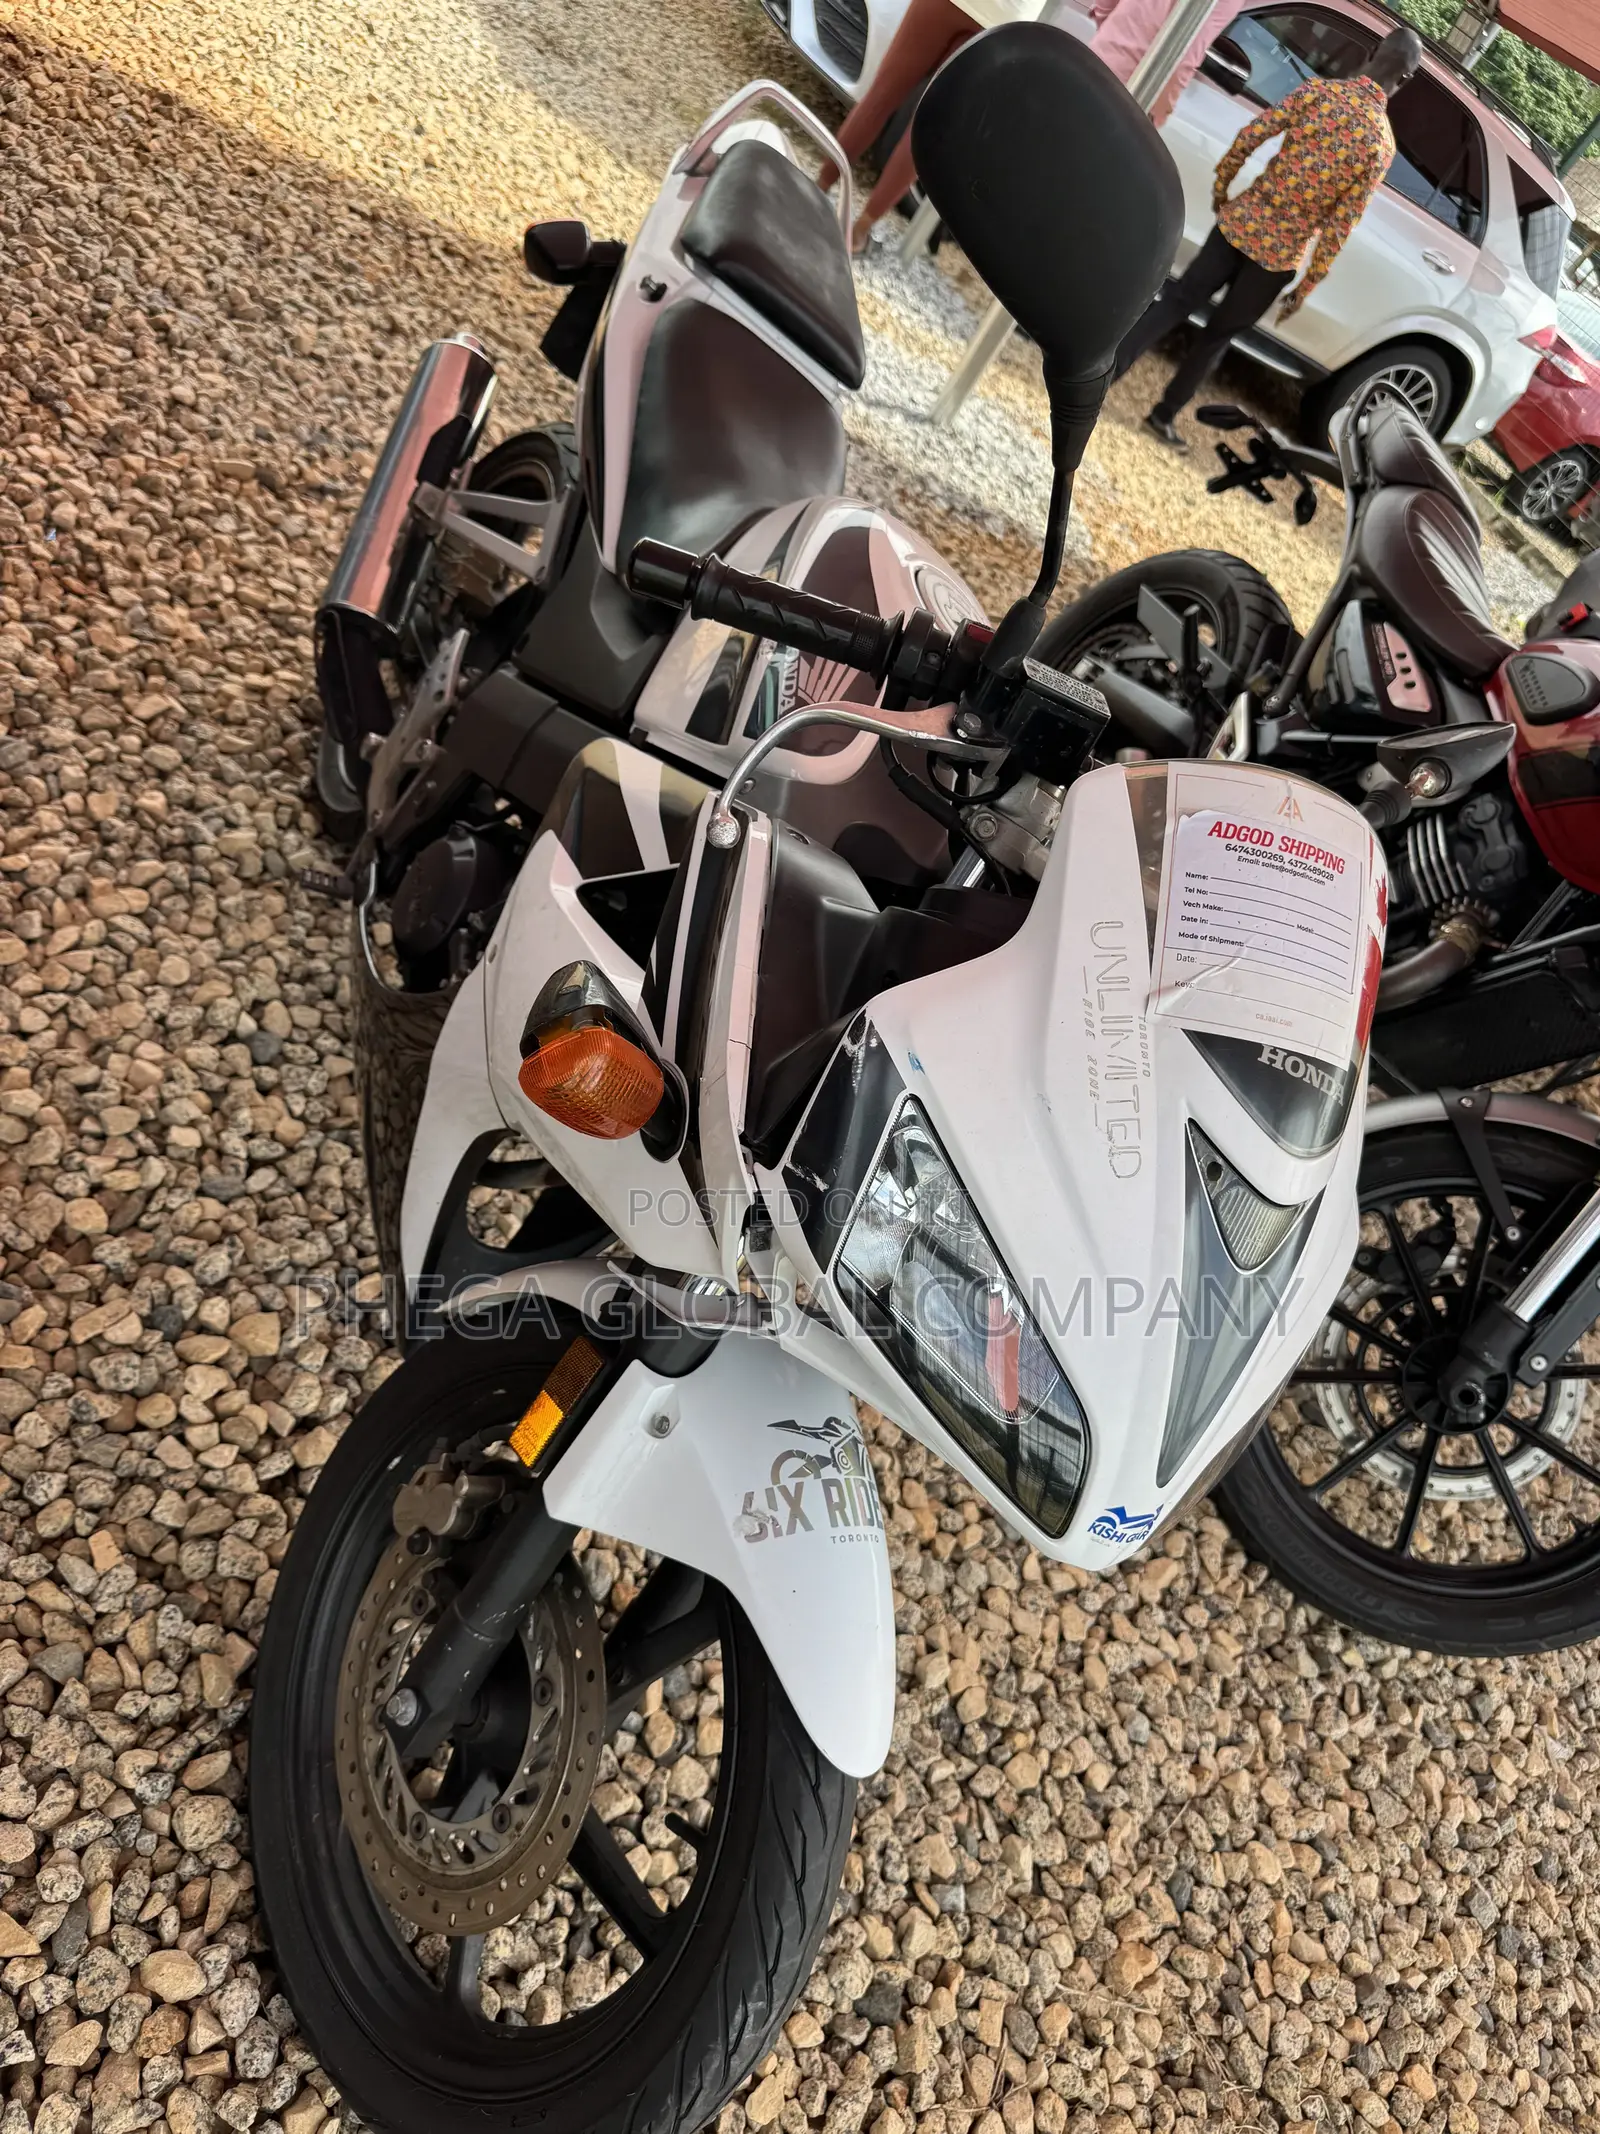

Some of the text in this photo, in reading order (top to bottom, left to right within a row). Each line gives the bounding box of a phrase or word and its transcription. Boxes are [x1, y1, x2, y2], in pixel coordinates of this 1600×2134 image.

[778, 645, 799, 716] ONDA
[1207, 821, 1346, 874] ADGOD SHIPPING
[1225, 843, 1335, 881] 6474300269, 4372489028
[1237, 855, 1326, 886] Email: sales@adgodinc.com
[1185, 871, 1209, 881] Name:
[1184, 886, 1209, 896] Tel No:
[1183, 900, 1201, 909] Vech
[1202, 903, 1224, 912] Make:
[1180, 915, 1209, 925] Date in:
[1178, 931, 1199, 941] Mode
[1208, 935, 1245, 948] Shipment:
[1176, 952, 1198, 964] Date:
[1257, 1043, 1345, 1107] HONDA
[740, 1480, 815, 1544] SIX
[830, 1534, 880, 1545] TORONTO
[1087, 1521, 1128, 1544] KISHI
